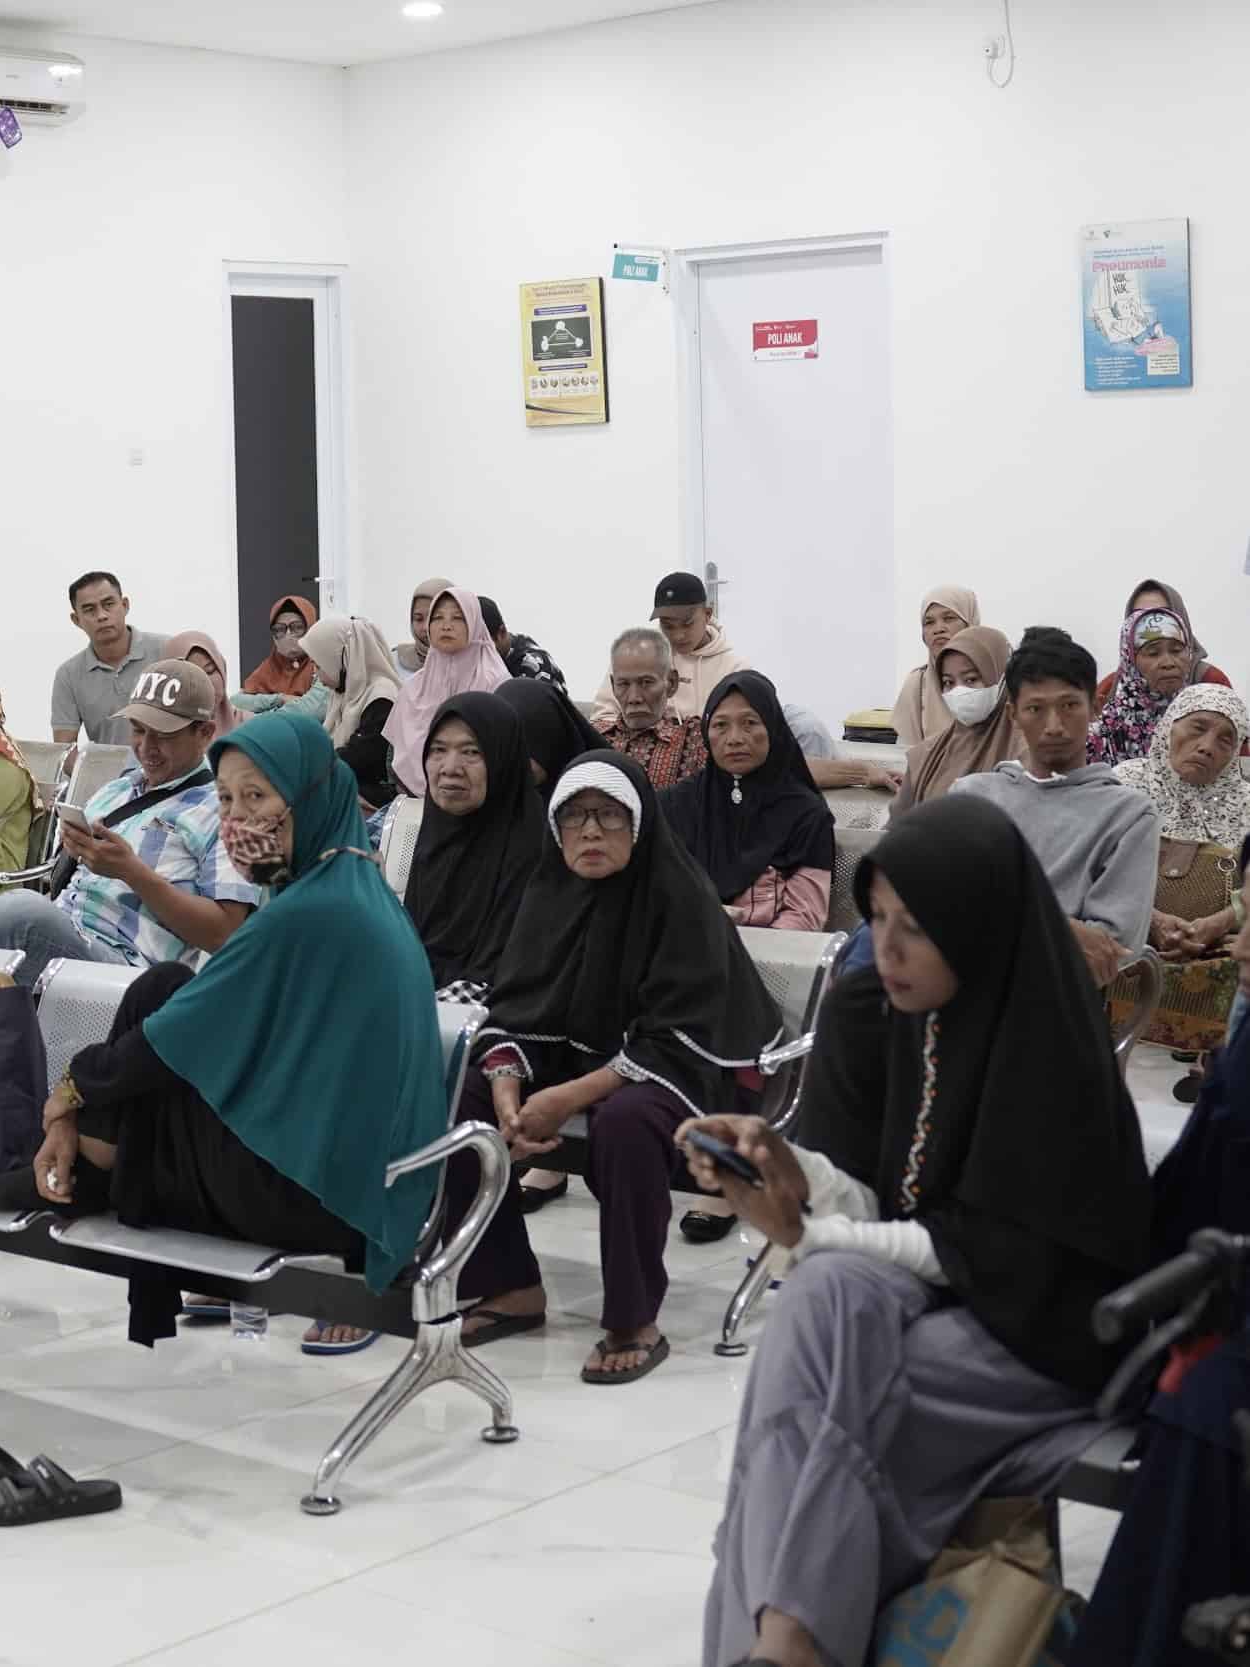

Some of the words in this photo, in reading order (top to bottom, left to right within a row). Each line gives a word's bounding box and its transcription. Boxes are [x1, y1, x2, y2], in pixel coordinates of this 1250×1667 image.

[767, 333, 782, 345] POLI
[783, 332, 803, 344] ANAK
[131, 672, 182, 707] NYC
